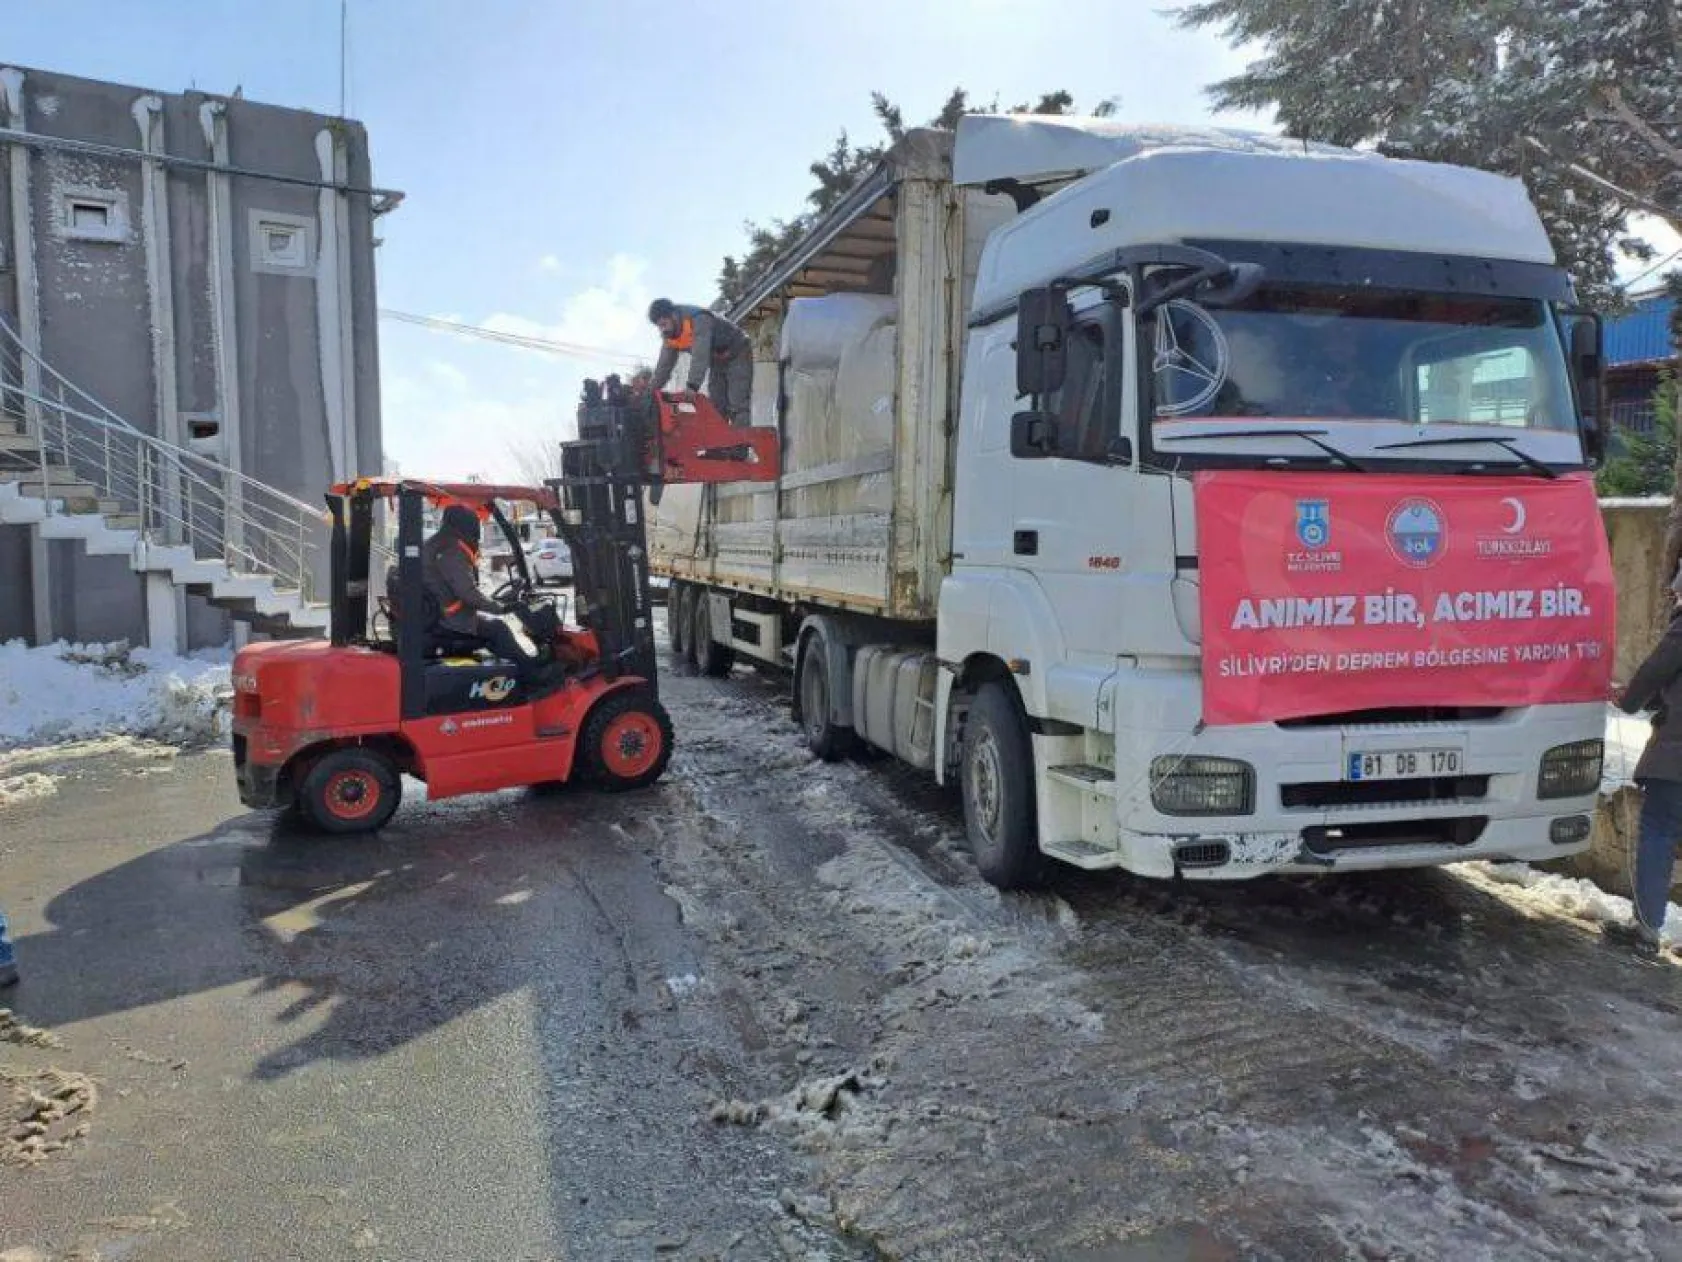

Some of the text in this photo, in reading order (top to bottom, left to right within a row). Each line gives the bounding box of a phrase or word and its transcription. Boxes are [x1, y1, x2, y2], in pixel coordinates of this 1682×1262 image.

[1231, 581, 1591, 630] ANIMIZ BİR, ACIMIZ BİR.
[1337, 651, 1408, 671] DEPREM
[1413, 645, 1509, 667] BÖLGESİNE
[1514, 642, 1569, 661] YARDIM
[1430, 751, 1457, 772] 170
